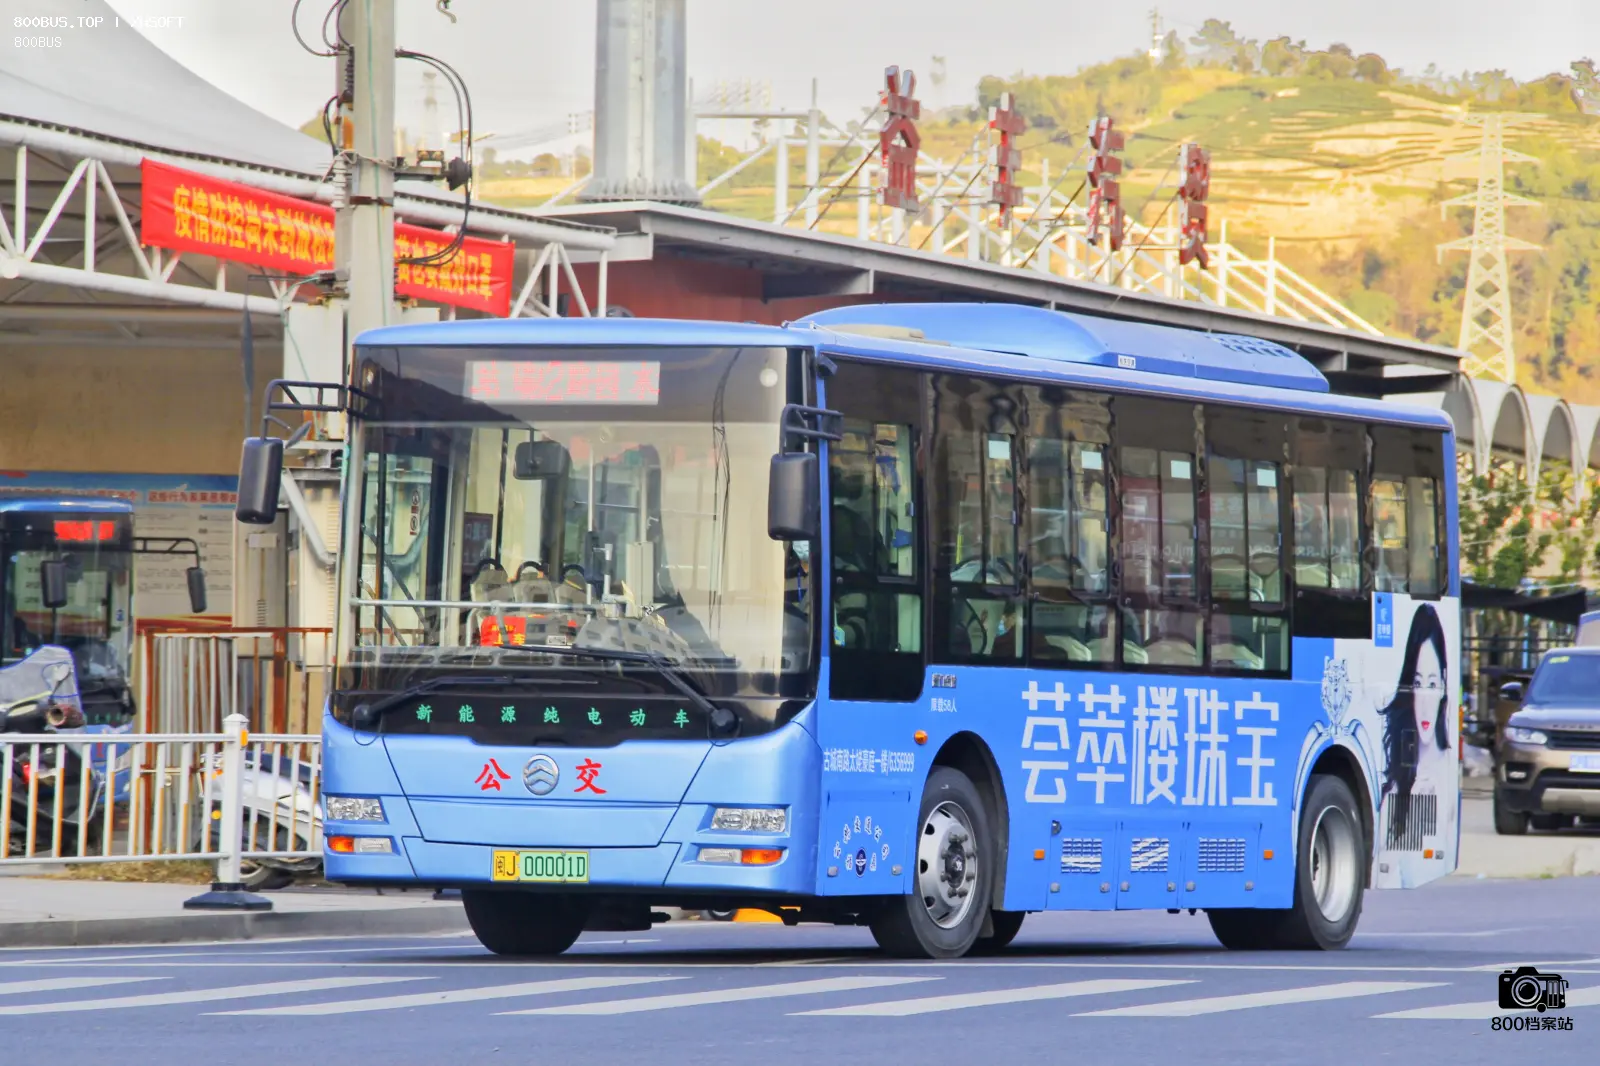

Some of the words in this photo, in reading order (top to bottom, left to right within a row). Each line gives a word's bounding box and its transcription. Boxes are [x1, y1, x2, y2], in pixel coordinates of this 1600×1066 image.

[415, 704, 690, 729] 新能源纯电动车
[1021, 680, 1280, 806] 荟萃楼珠宝
